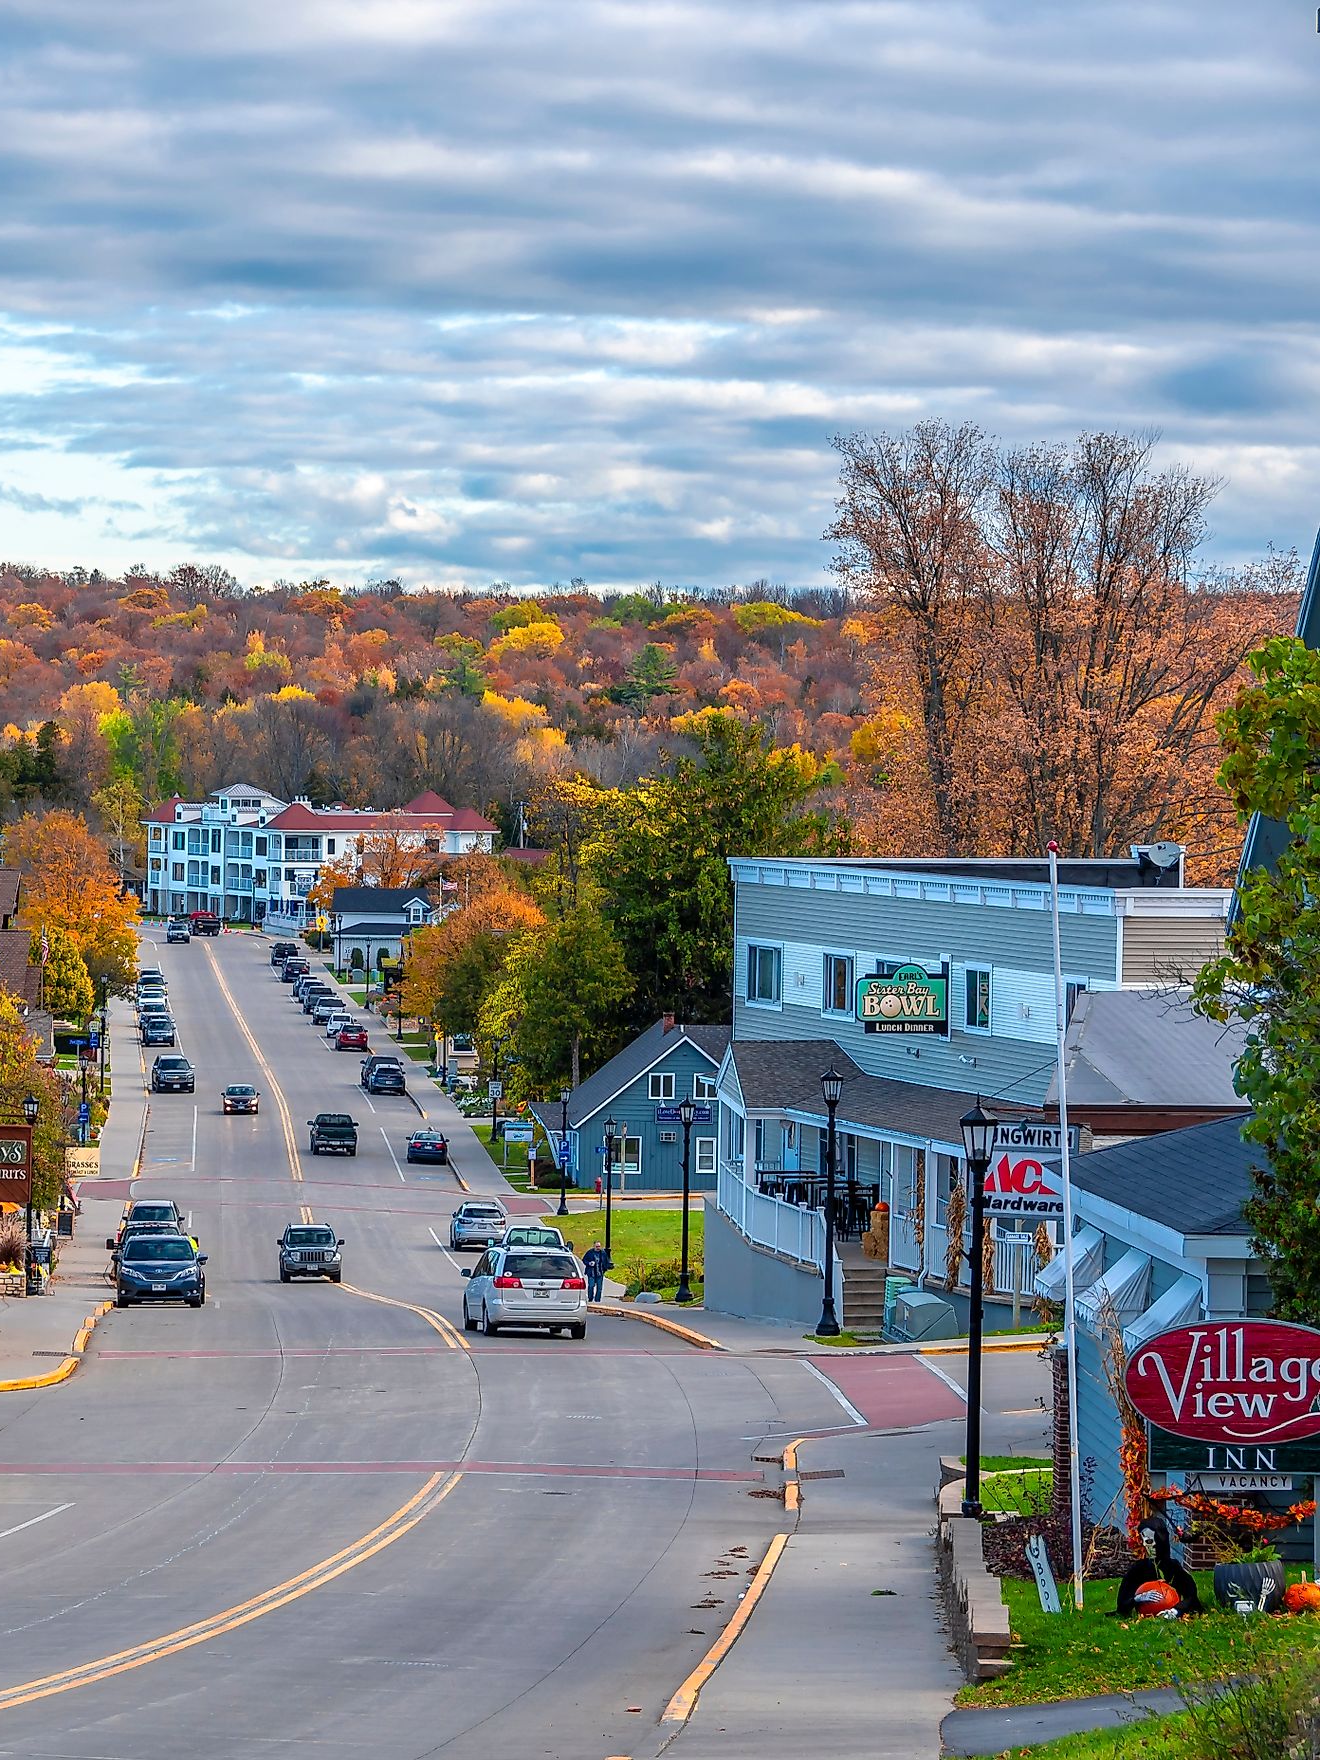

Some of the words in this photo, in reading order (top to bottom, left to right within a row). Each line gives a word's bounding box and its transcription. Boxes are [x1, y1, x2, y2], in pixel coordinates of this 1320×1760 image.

[898, 971, 923, 981] EARL'S
[868, 982, 906, 995] Sister
[907, 982, 929, 998] Bay
[863, 995, 940, 1018] BOWL
[490, 1089, 501, 1097] 30
[81, 1103, 87, 1112] P
[561, 1141, 568, 1150] P
[1206, 1447, 1277, 1471] INN
[1219, 1475, 1289, 1488] VACANCY
